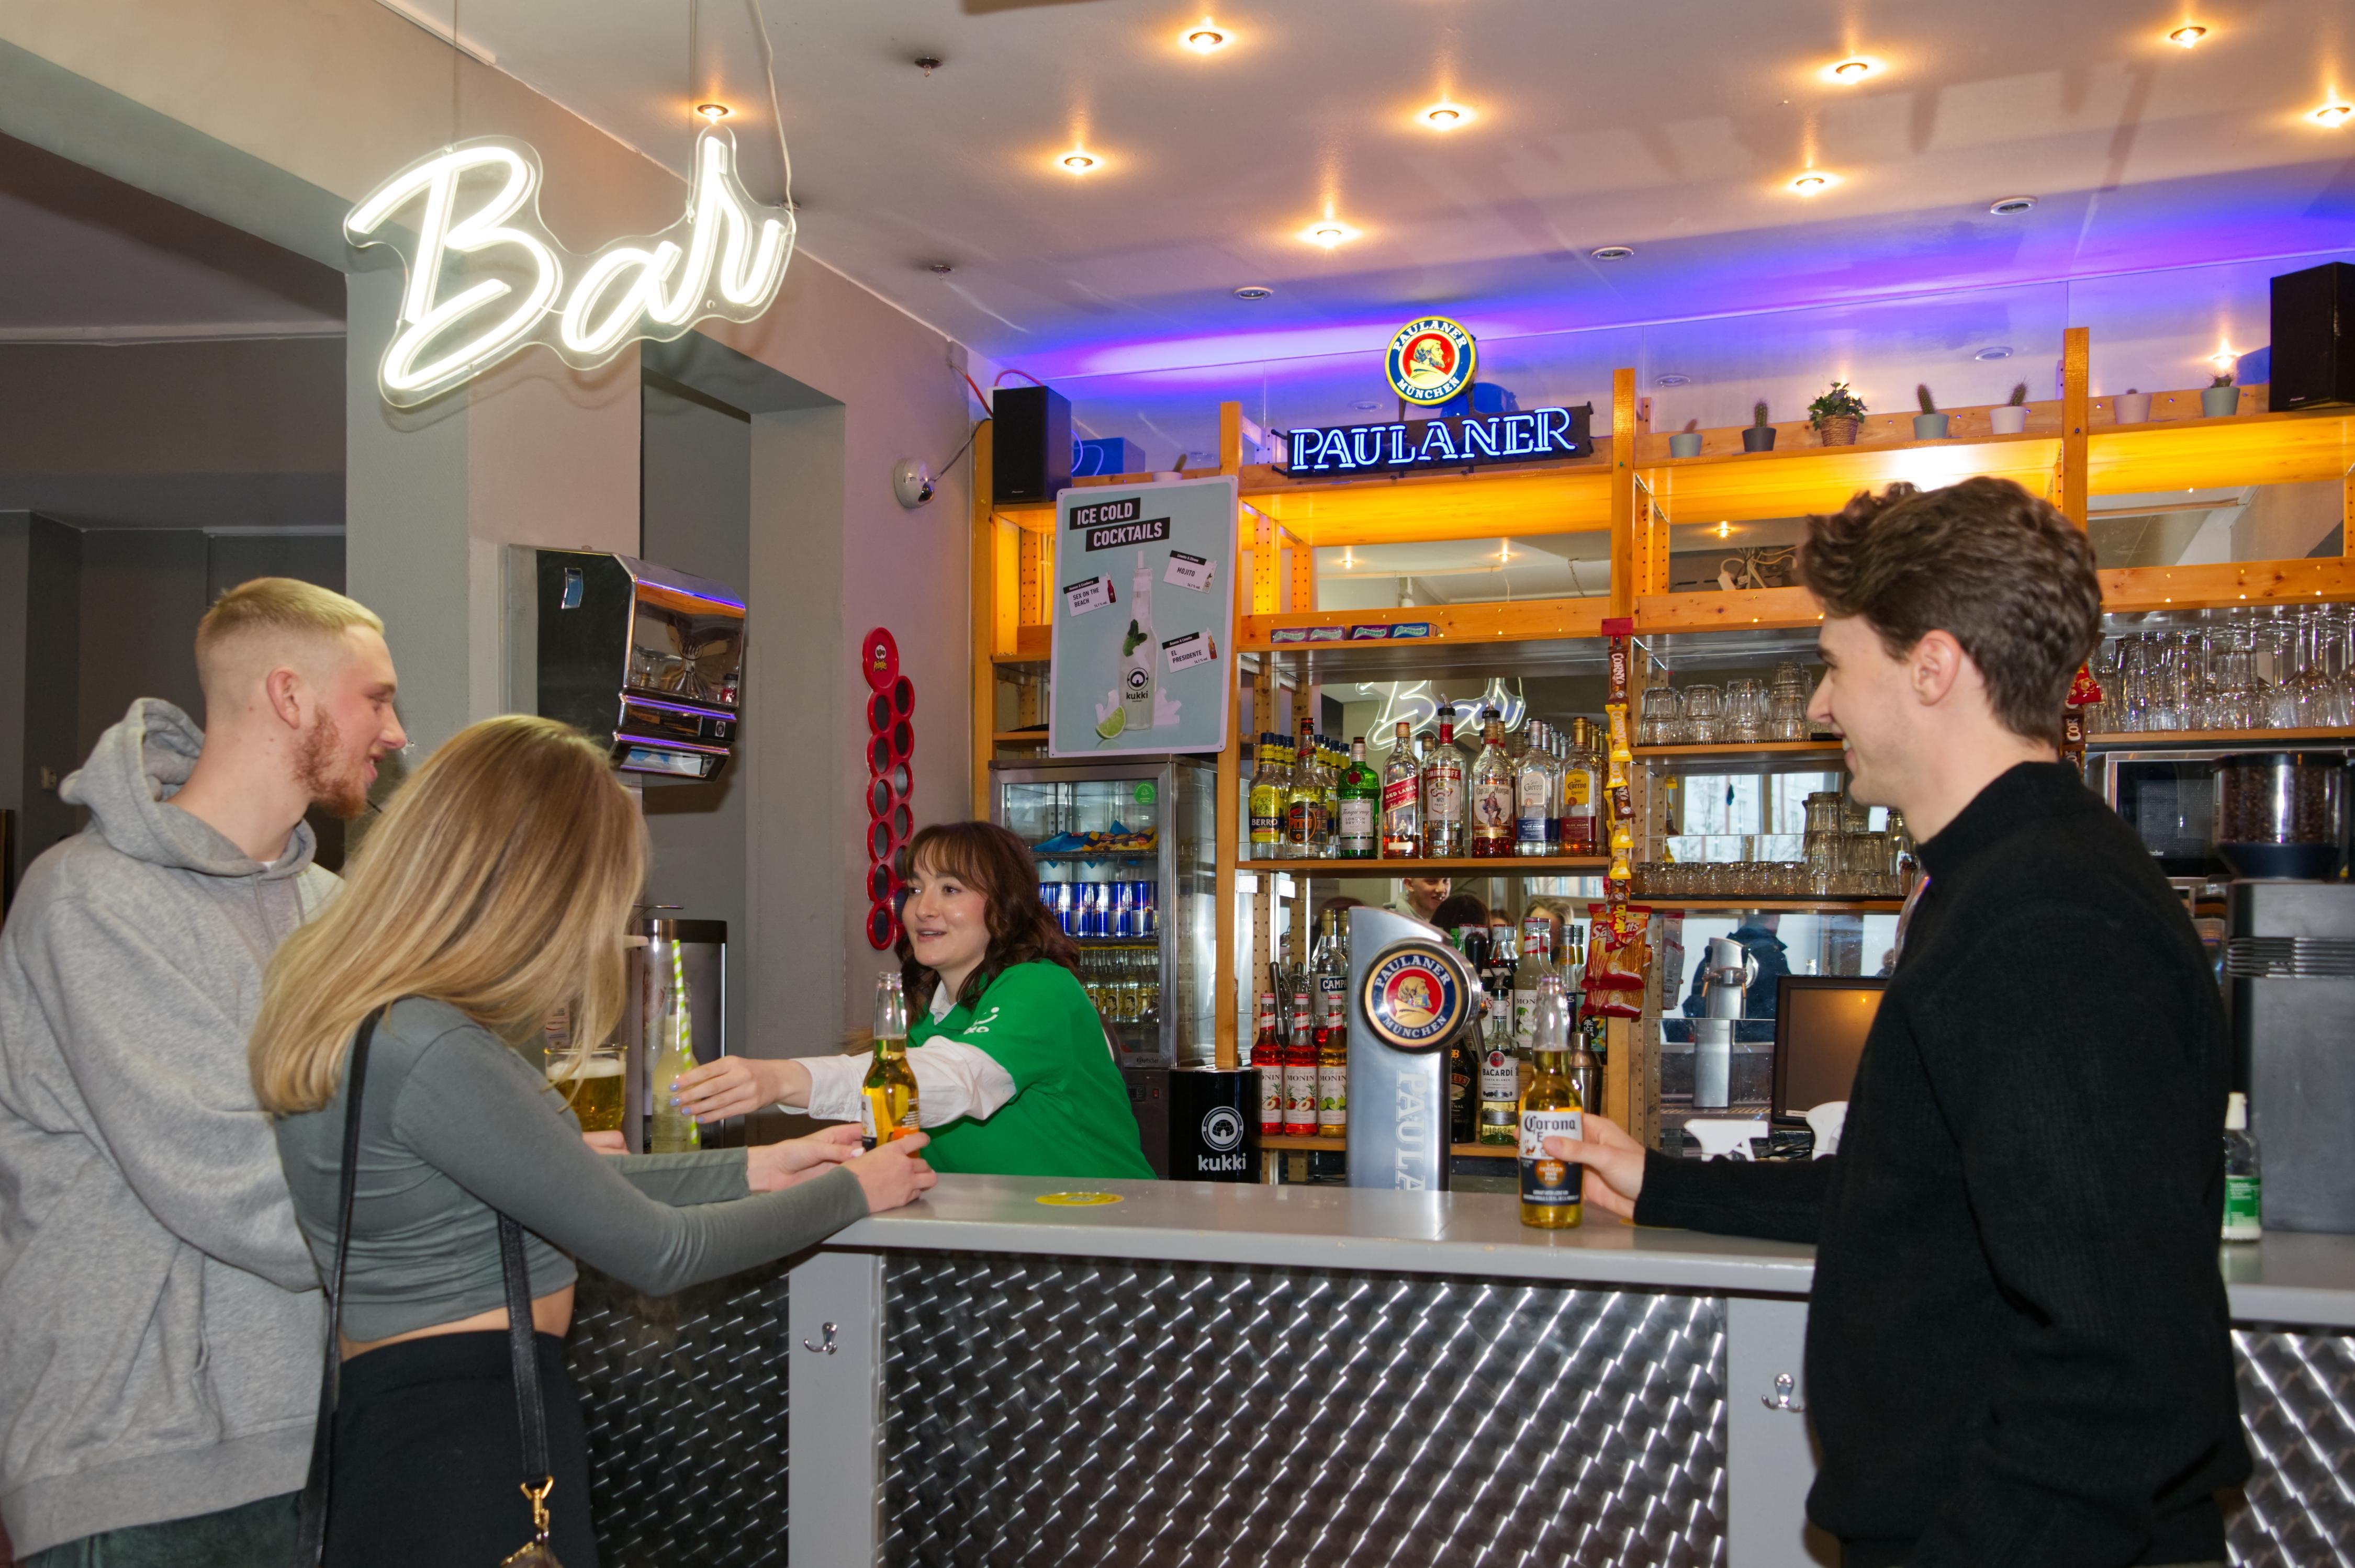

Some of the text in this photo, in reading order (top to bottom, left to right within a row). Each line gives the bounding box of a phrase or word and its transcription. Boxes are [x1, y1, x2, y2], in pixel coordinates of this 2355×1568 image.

[345, 136, 786, 391] Bar
[1392, 320, 1467, 352] PAULANER
[1396, 376, 1460, 399] MÜNCHEN
[1291, 406, 1576, 470] PAULANER
[1077, 502, 1134, 526] ICE COLD
[1093, 522, 1163, 547] COCKTAILS
[1176, 566, 1196, 577] MOJITO
[1073, 592, 1082, 601] SEX
[1074, 598, 1090, 607] BEACH
[1355, 627, 1386, 638] Airwaves
[1394, 626, 1426, 637] Airwaves
[1172, 650, 1203, 664] PRESIDENTE
[1611, 652, 1626, 683] CORNY
[1126, 691, 1149, 700] kukki
[1427, 769, 1459, 779] SMIRNOFF
[1398, 785, 1417, 795] LABEL
[1567, 782, 1587, 790] Cuervo
[1289, 816, 1313, 829] PITÚ
[1375, 955, 1451, 988] PAULANER
[1382, 1014, 1447, 1037] MÜNCHEN
[1482, 1067, 1513, 1077] BACARDÍ
[1524, 1115, 1577, 1135] Corona
[1197, 1152, 1247, 1171] kukki
